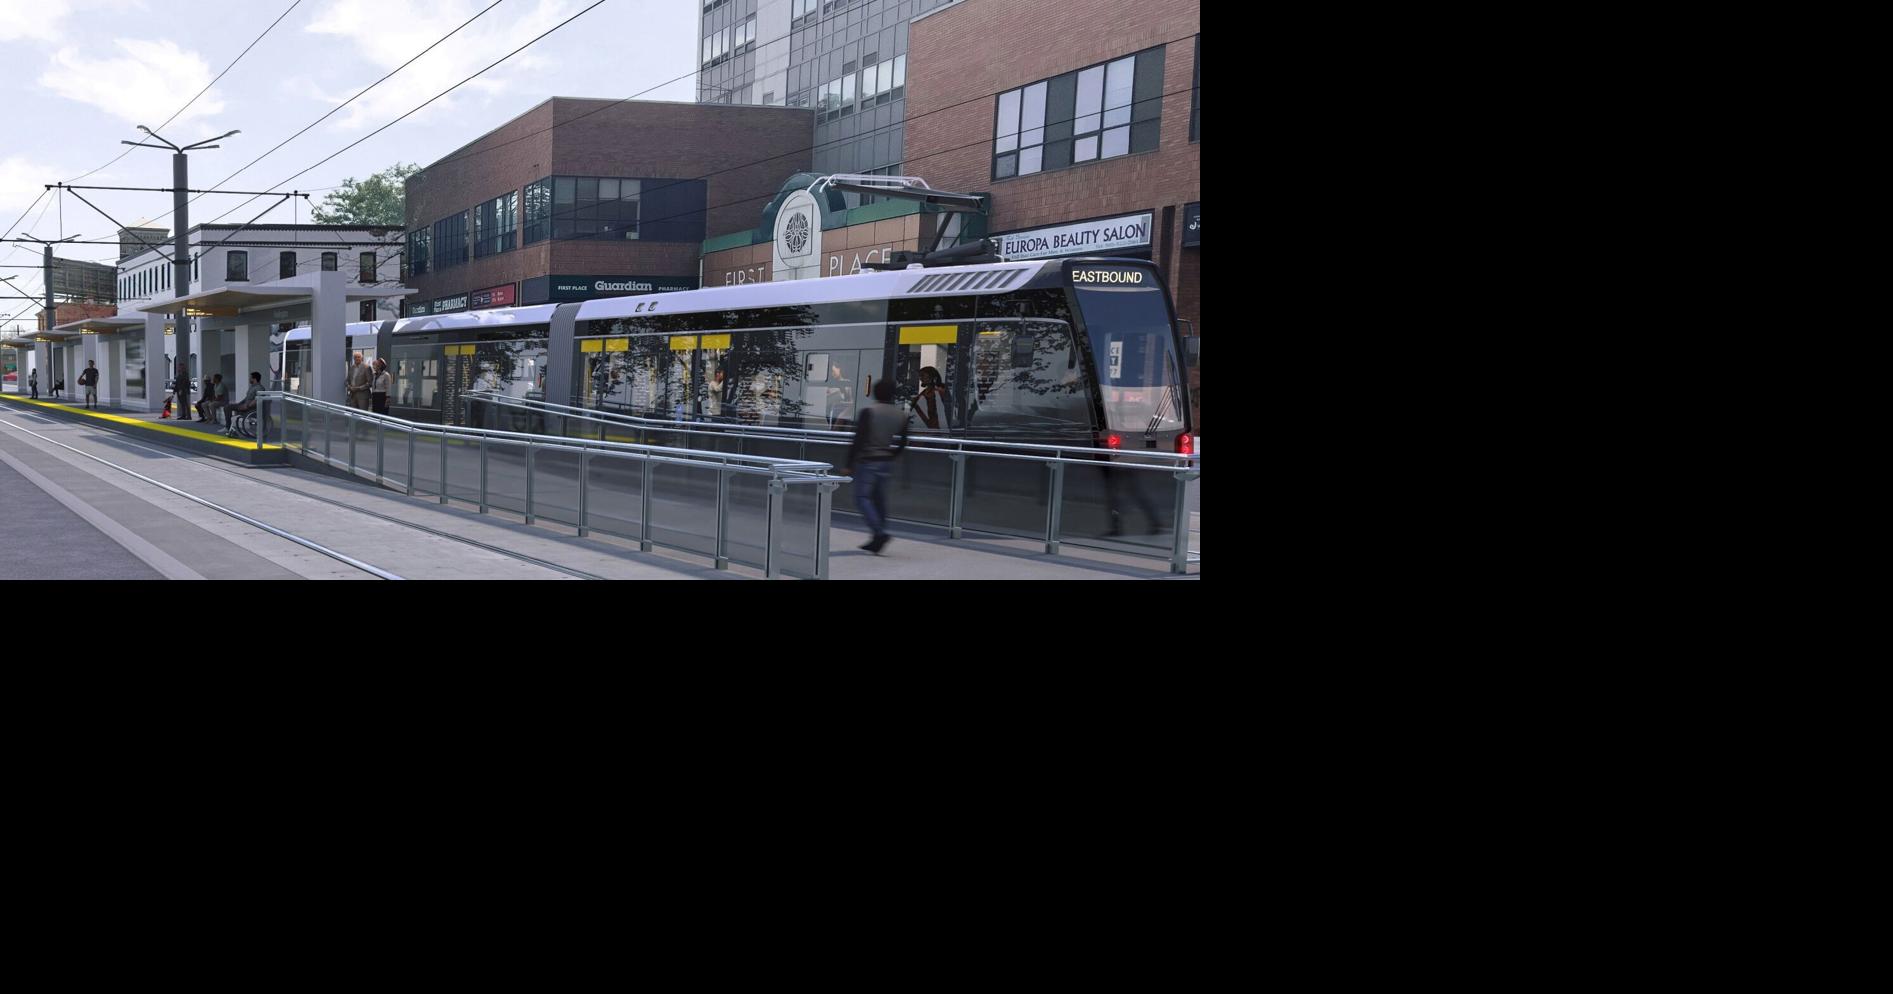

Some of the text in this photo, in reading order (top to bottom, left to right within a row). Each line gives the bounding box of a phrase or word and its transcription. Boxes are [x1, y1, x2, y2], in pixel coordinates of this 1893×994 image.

[1005, 237, 1049, 255] EUROPA
[1053, 230, 1100, 249] BEAUTY
[1103, 223, 1146, 242] SALON
[725, 266, 766, 287] FIRST
[1072, 270, 1143, 284] EASTBOUND
[594, 280, 652, 292] Guardian
[441, 296, 468, 311] PHARMACY
